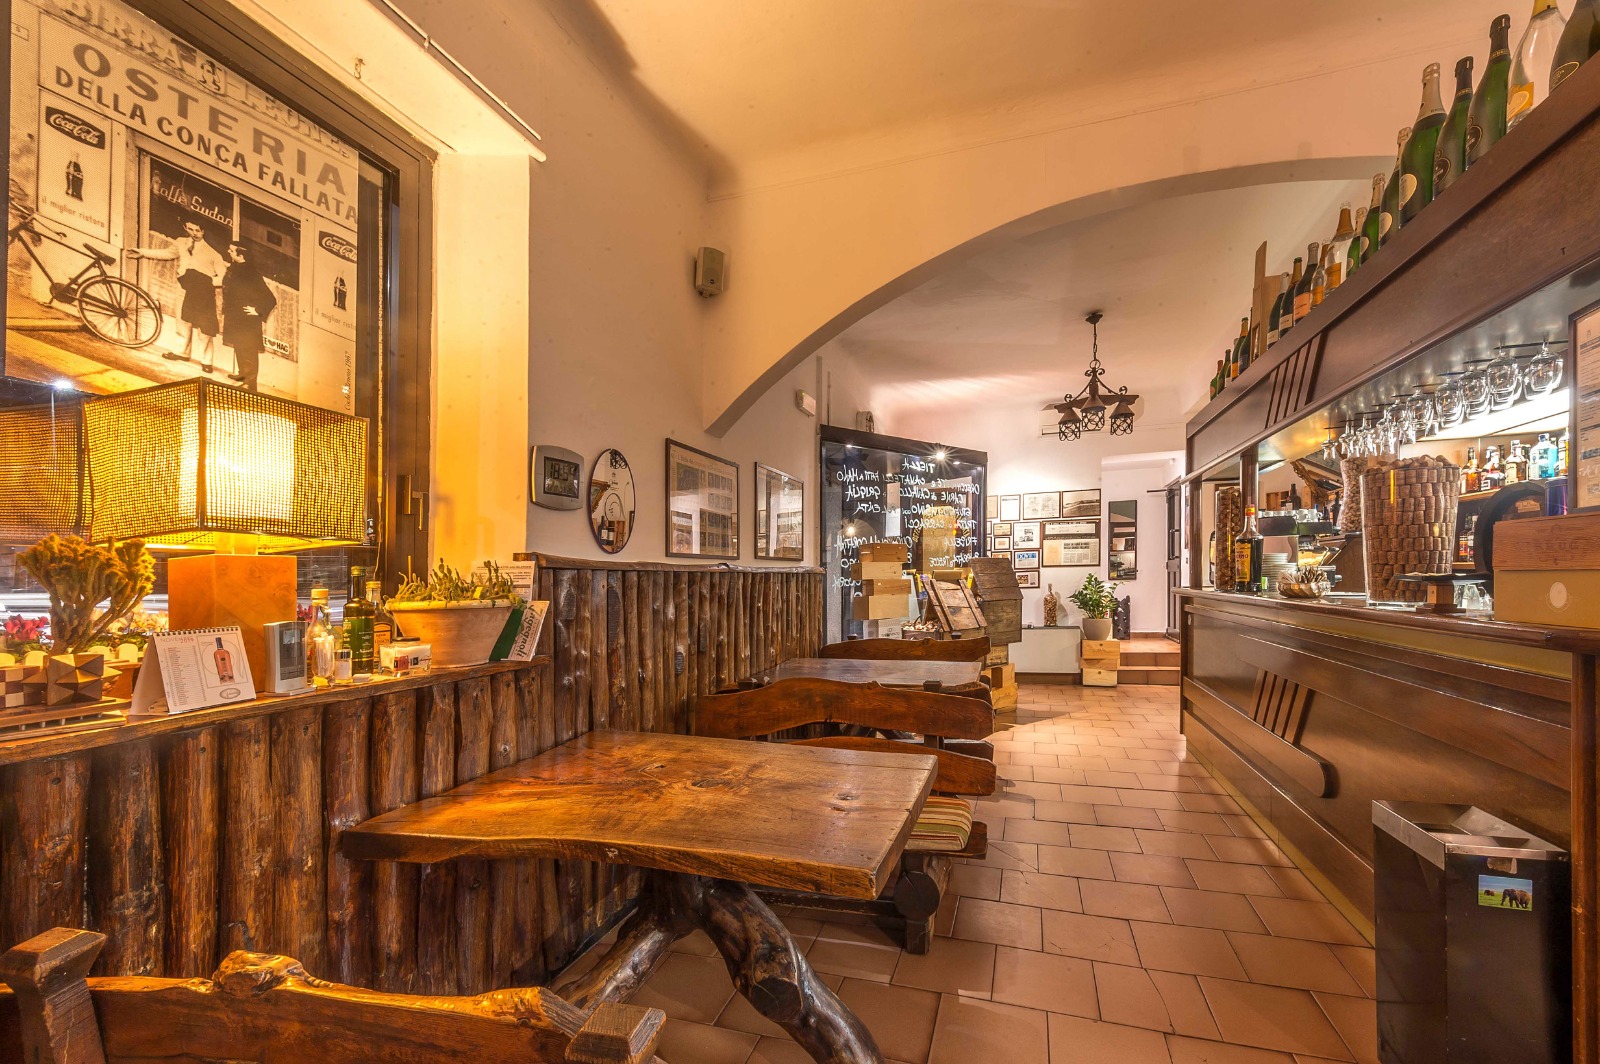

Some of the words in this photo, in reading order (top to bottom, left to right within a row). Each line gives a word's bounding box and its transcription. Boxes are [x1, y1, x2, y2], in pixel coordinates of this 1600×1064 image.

[55, 65, 148, 126] DELLA
[156, 116, 249, 174] CONCA
[258, 161, 358, 225] FALLATA
[72, 42, 349, 196] OSTERIA
[190, 195, 234, 228] Sudan
